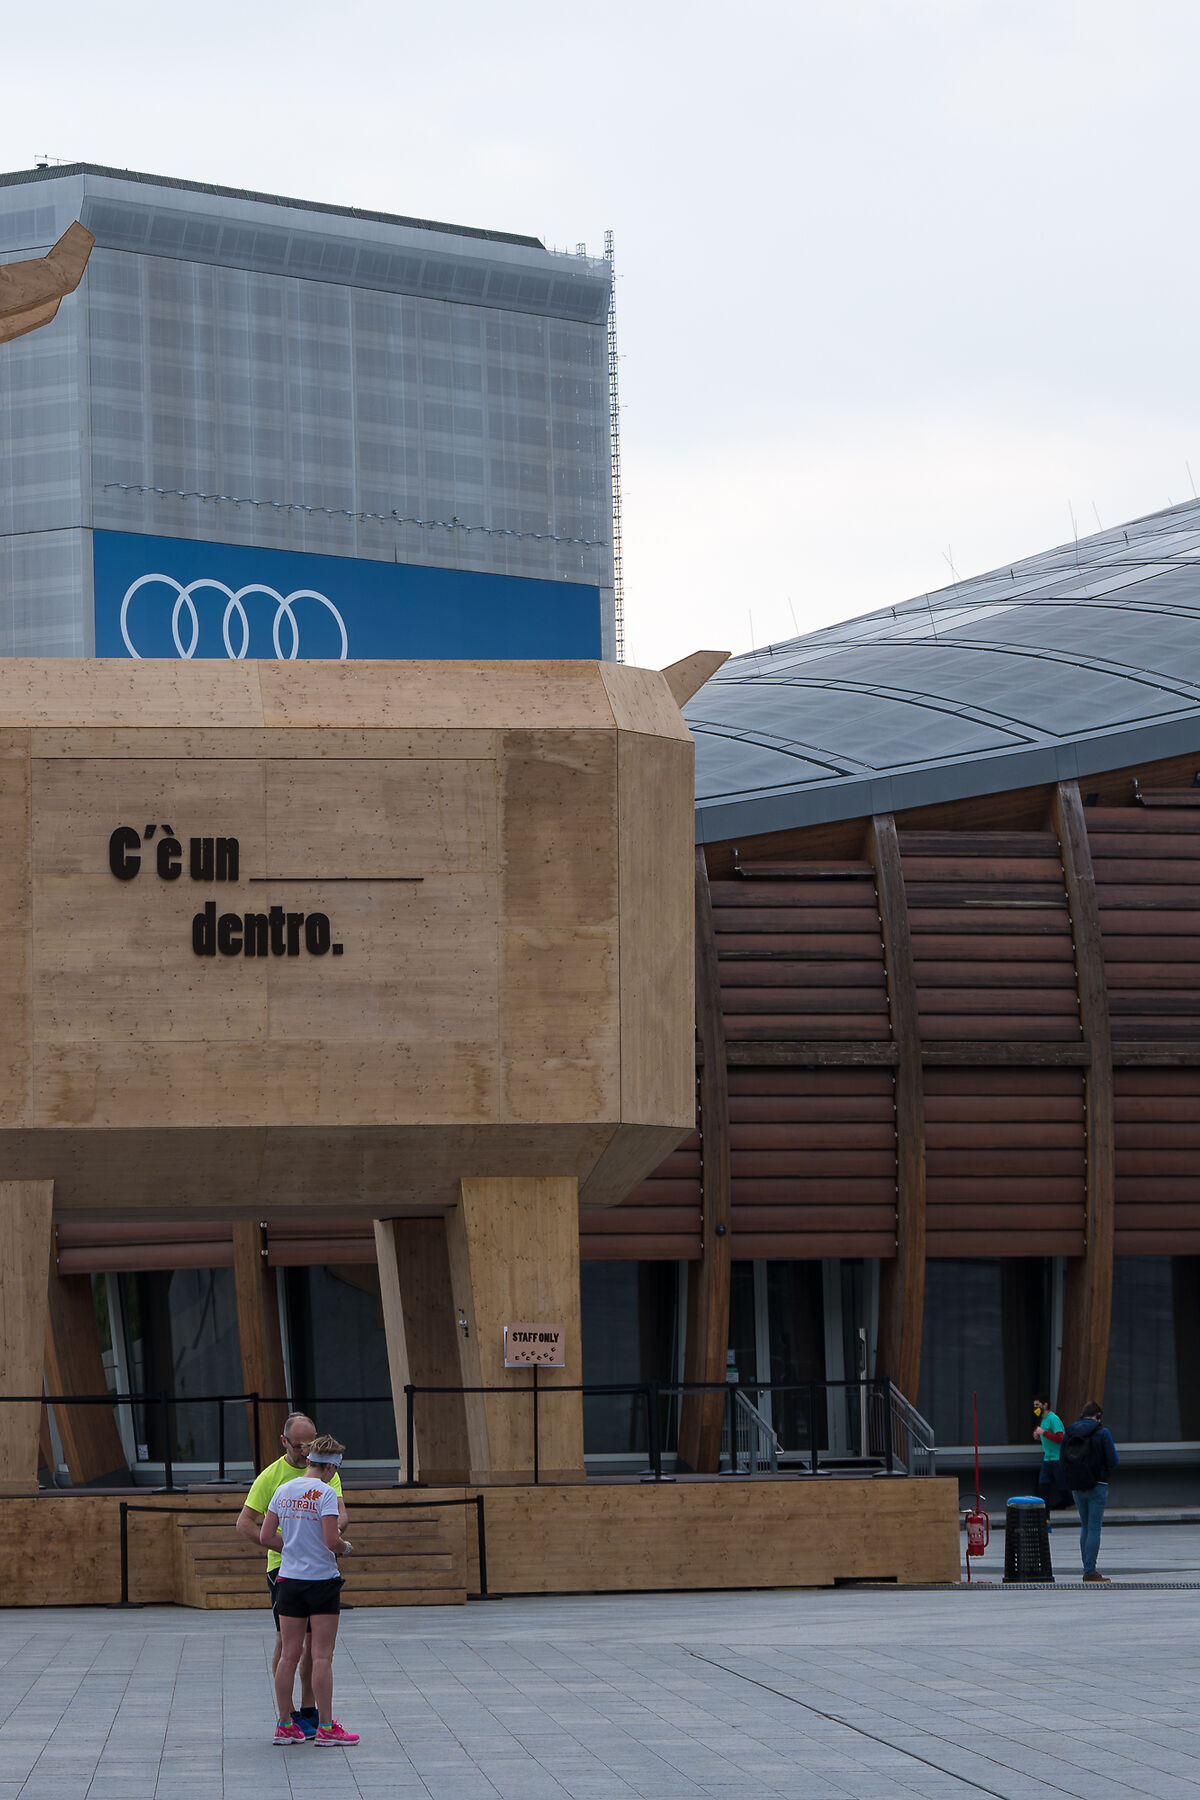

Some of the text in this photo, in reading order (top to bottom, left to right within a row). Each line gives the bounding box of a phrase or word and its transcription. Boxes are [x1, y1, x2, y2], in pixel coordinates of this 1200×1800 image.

[190, 837, 240, 881] un
[192, 901, 344, 956] dentro.
[512, 1332, 559, 1343] STAFF ONLY
